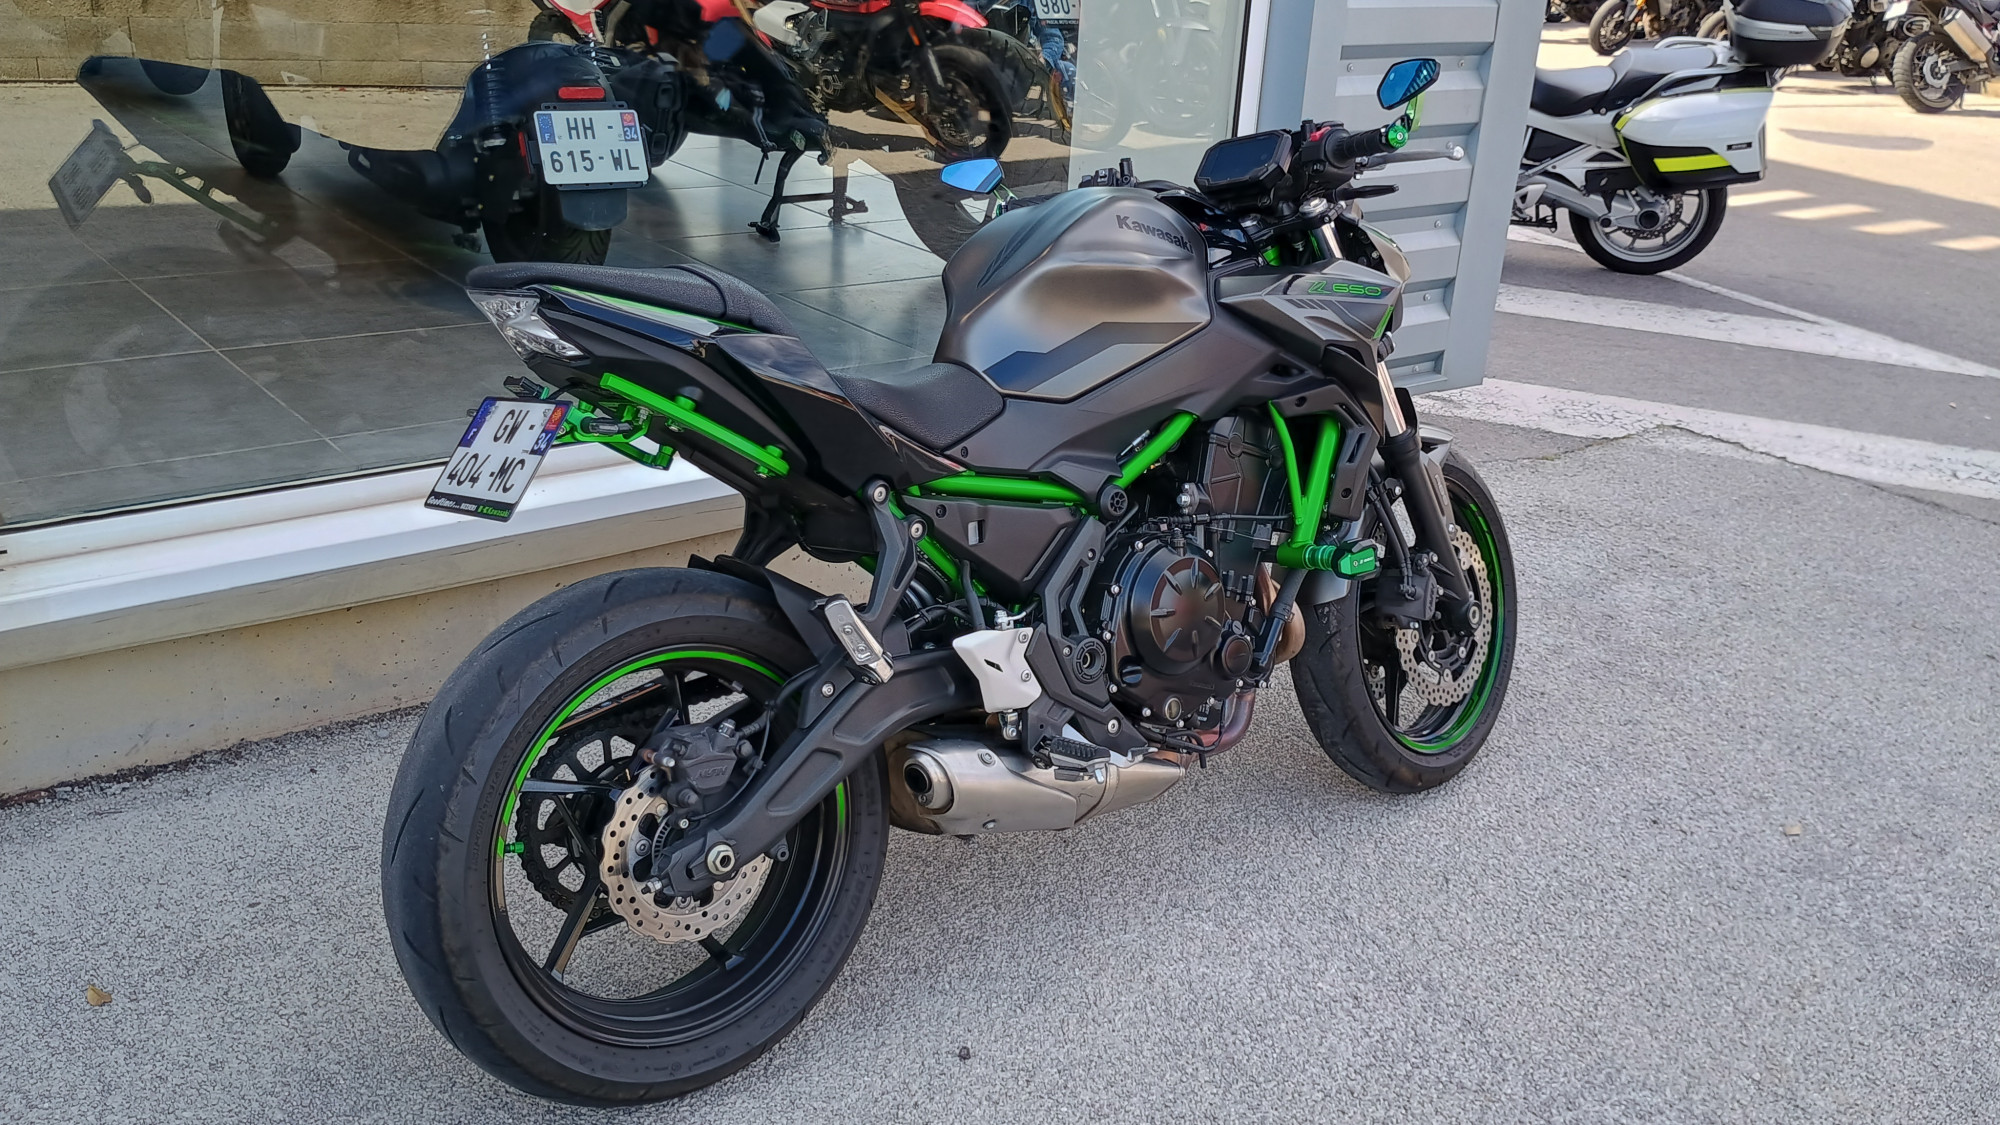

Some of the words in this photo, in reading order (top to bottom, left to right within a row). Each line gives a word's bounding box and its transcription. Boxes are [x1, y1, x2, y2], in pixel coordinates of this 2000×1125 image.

[545, 133, 550, 141] F
[624, 127, 637, 139] 34
[550, 149, 639, 173] 615-WL
[1115, 214, 1195, 255] Kawasaki
[468, 429, 477, 440] F
[534, 433, 551, 450] 34
[446, 451, 526, 494] 404-MC
